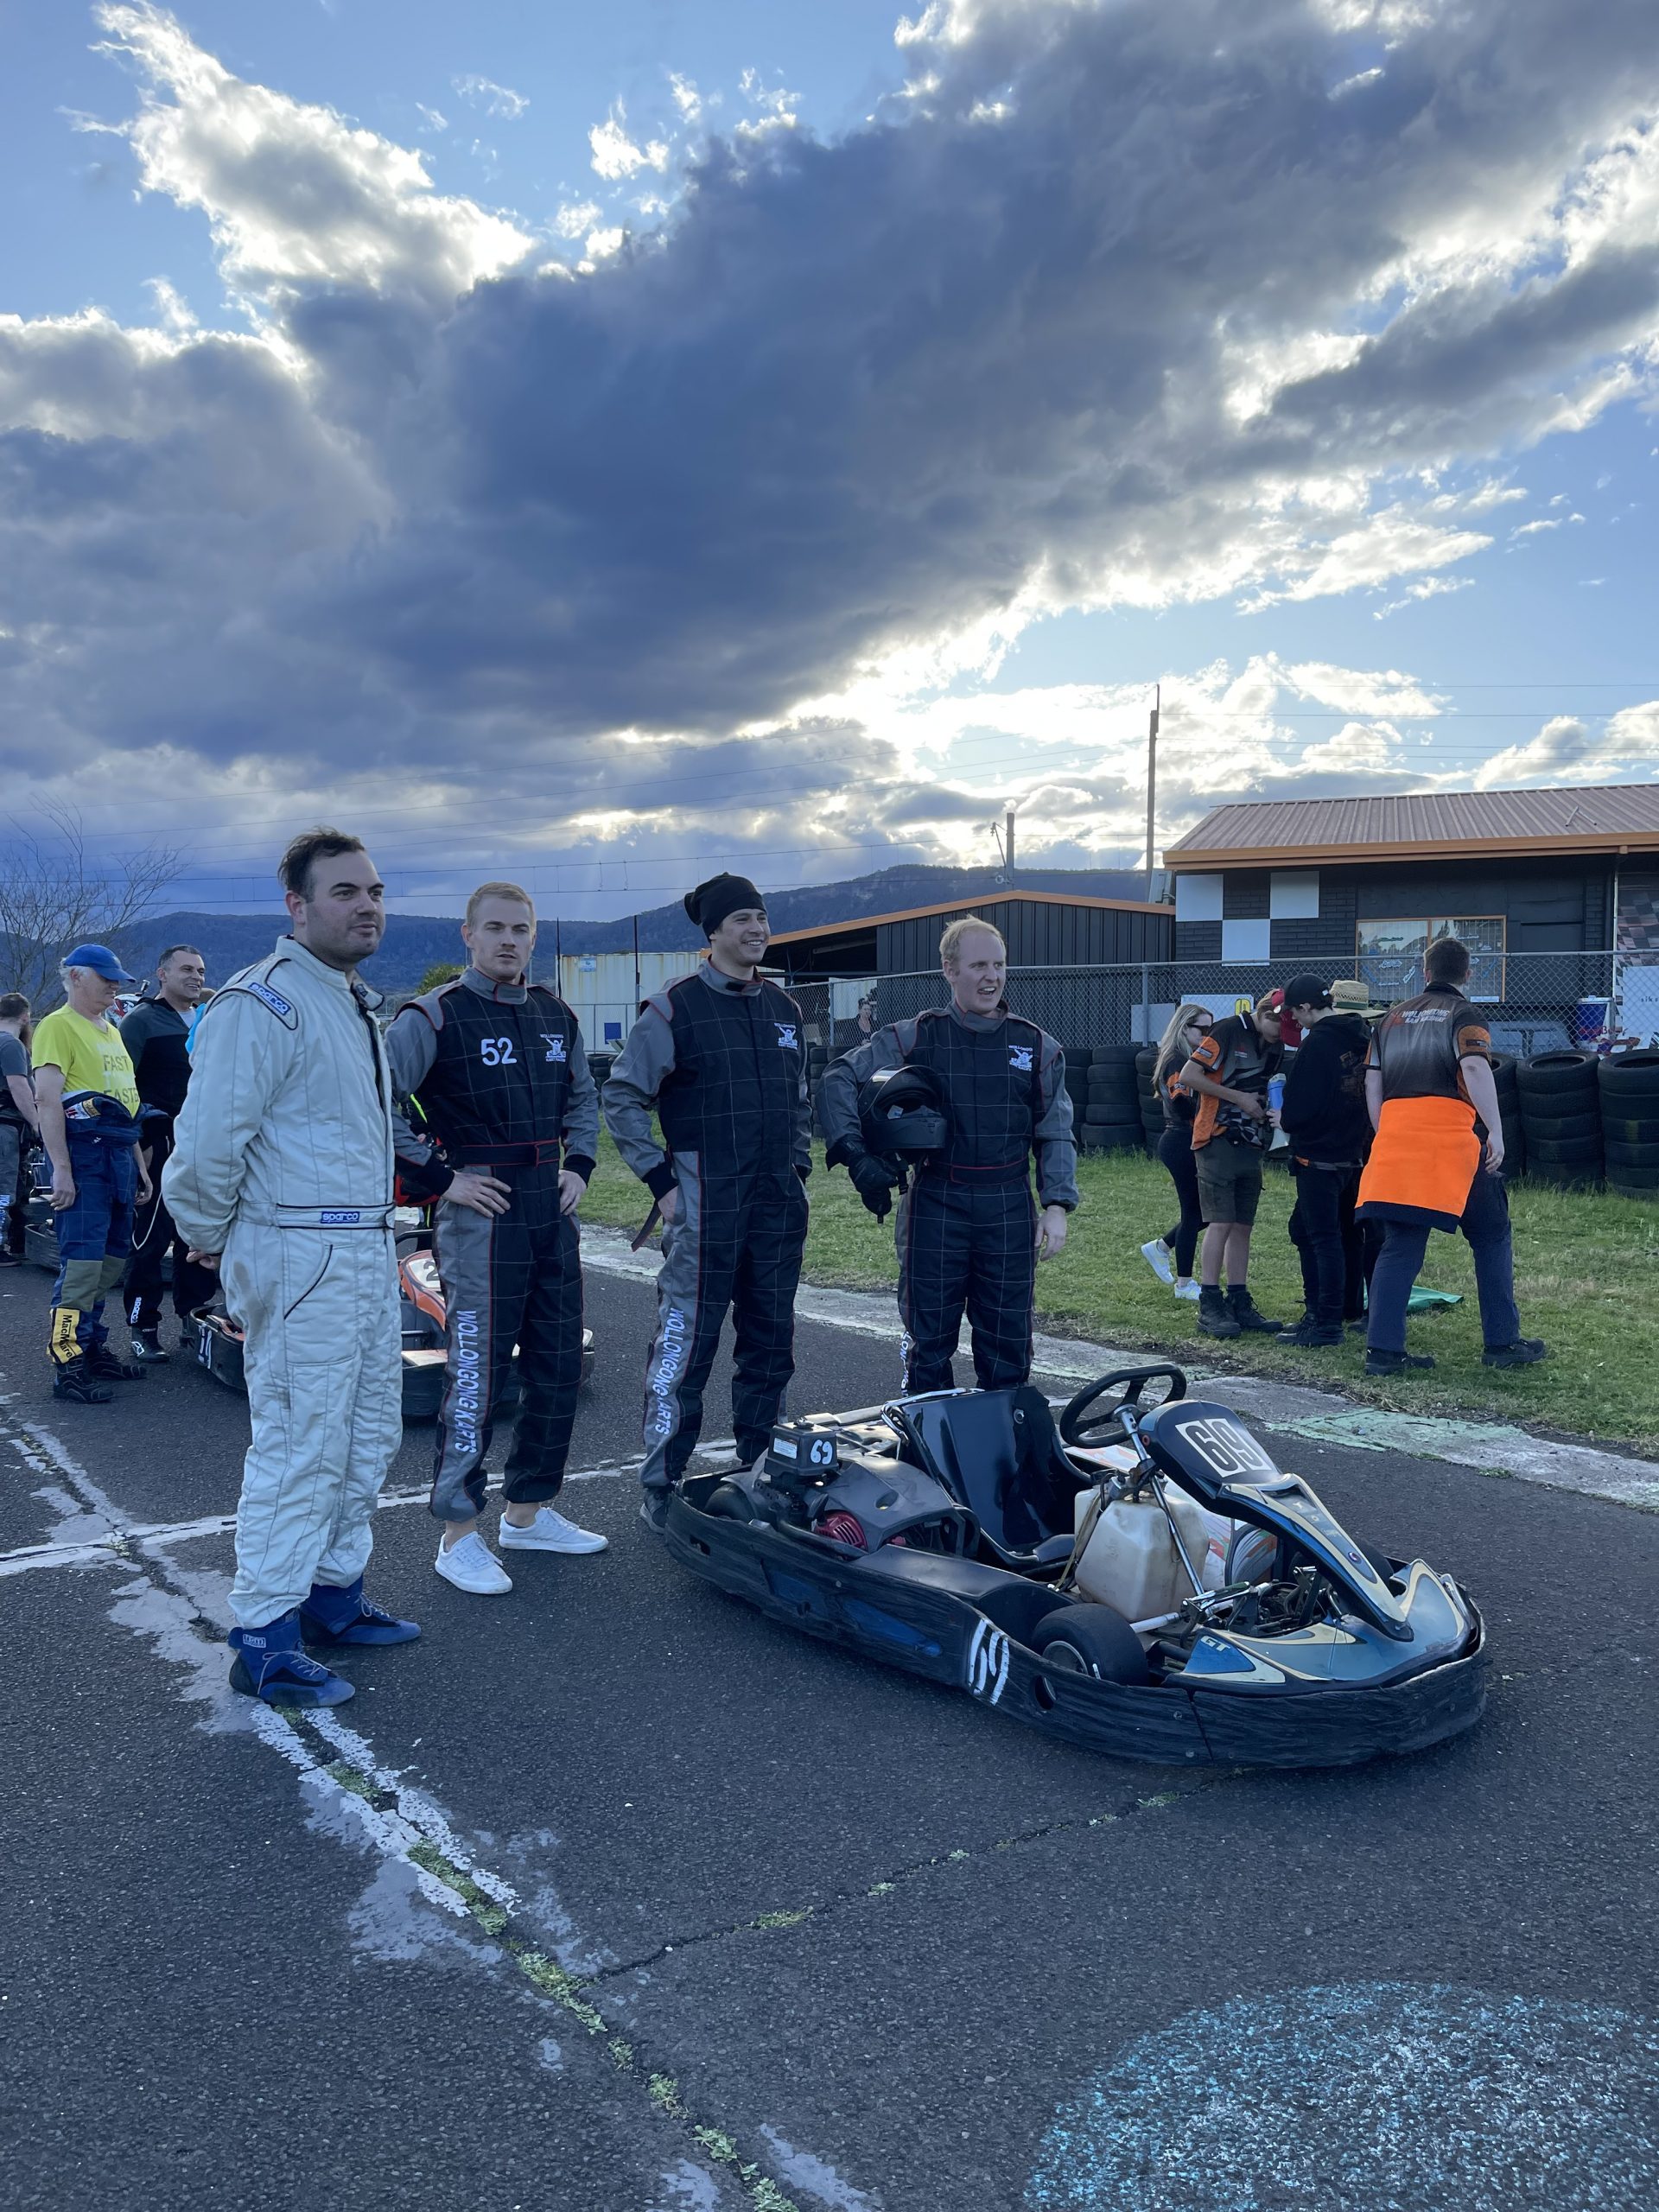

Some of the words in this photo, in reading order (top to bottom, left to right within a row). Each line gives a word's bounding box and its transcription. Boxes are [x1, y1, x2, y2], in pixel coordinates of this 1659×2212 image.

[103, 1054, 131, 1072] FAST
[480, 1037, 518, 1066] 52
[321, 1212, 359, 1224] sparco
[456, 1310, 480, 1409] WOLLONGONG
[652, 1307, 686, 1396] WOLLONGONG
[810, 1439, 833, 1465] 69
[1185, 1421, 1263, 1471] 69
[1200, 1635, 1231, 1652] GT
